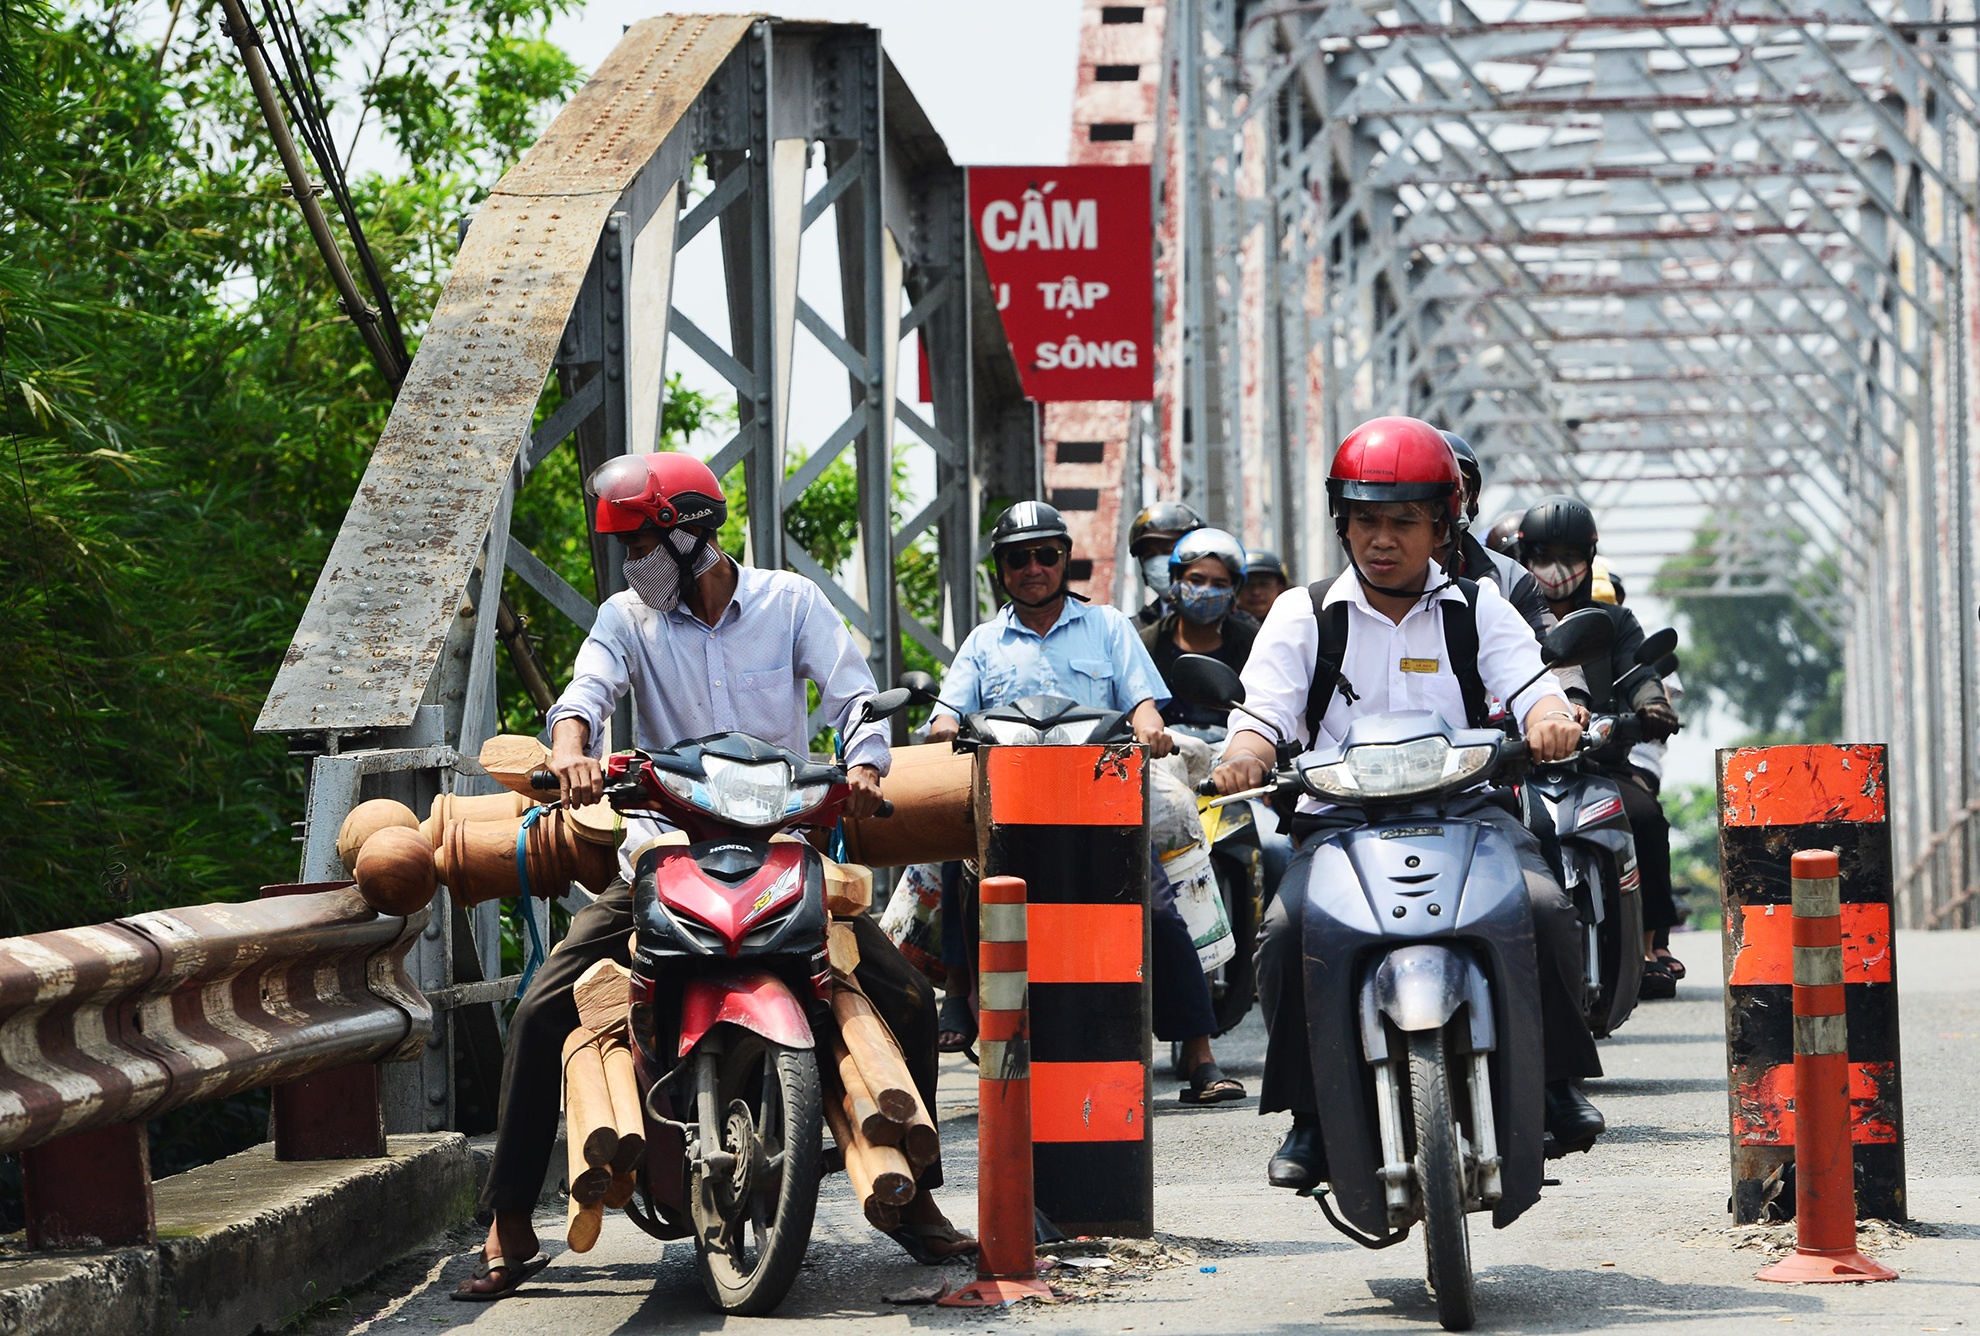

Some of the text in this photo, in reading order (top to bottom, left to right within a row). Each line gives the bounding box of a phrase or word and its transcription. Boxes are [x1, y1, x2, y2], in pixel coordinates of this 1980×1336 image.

[981, 181, 1098, 252] CẤM
[1037, 275, 1109, 319] TẬP
[1036, 334, 1138, 369] SÔNG
[709, 844, 753, 853] HONDA
